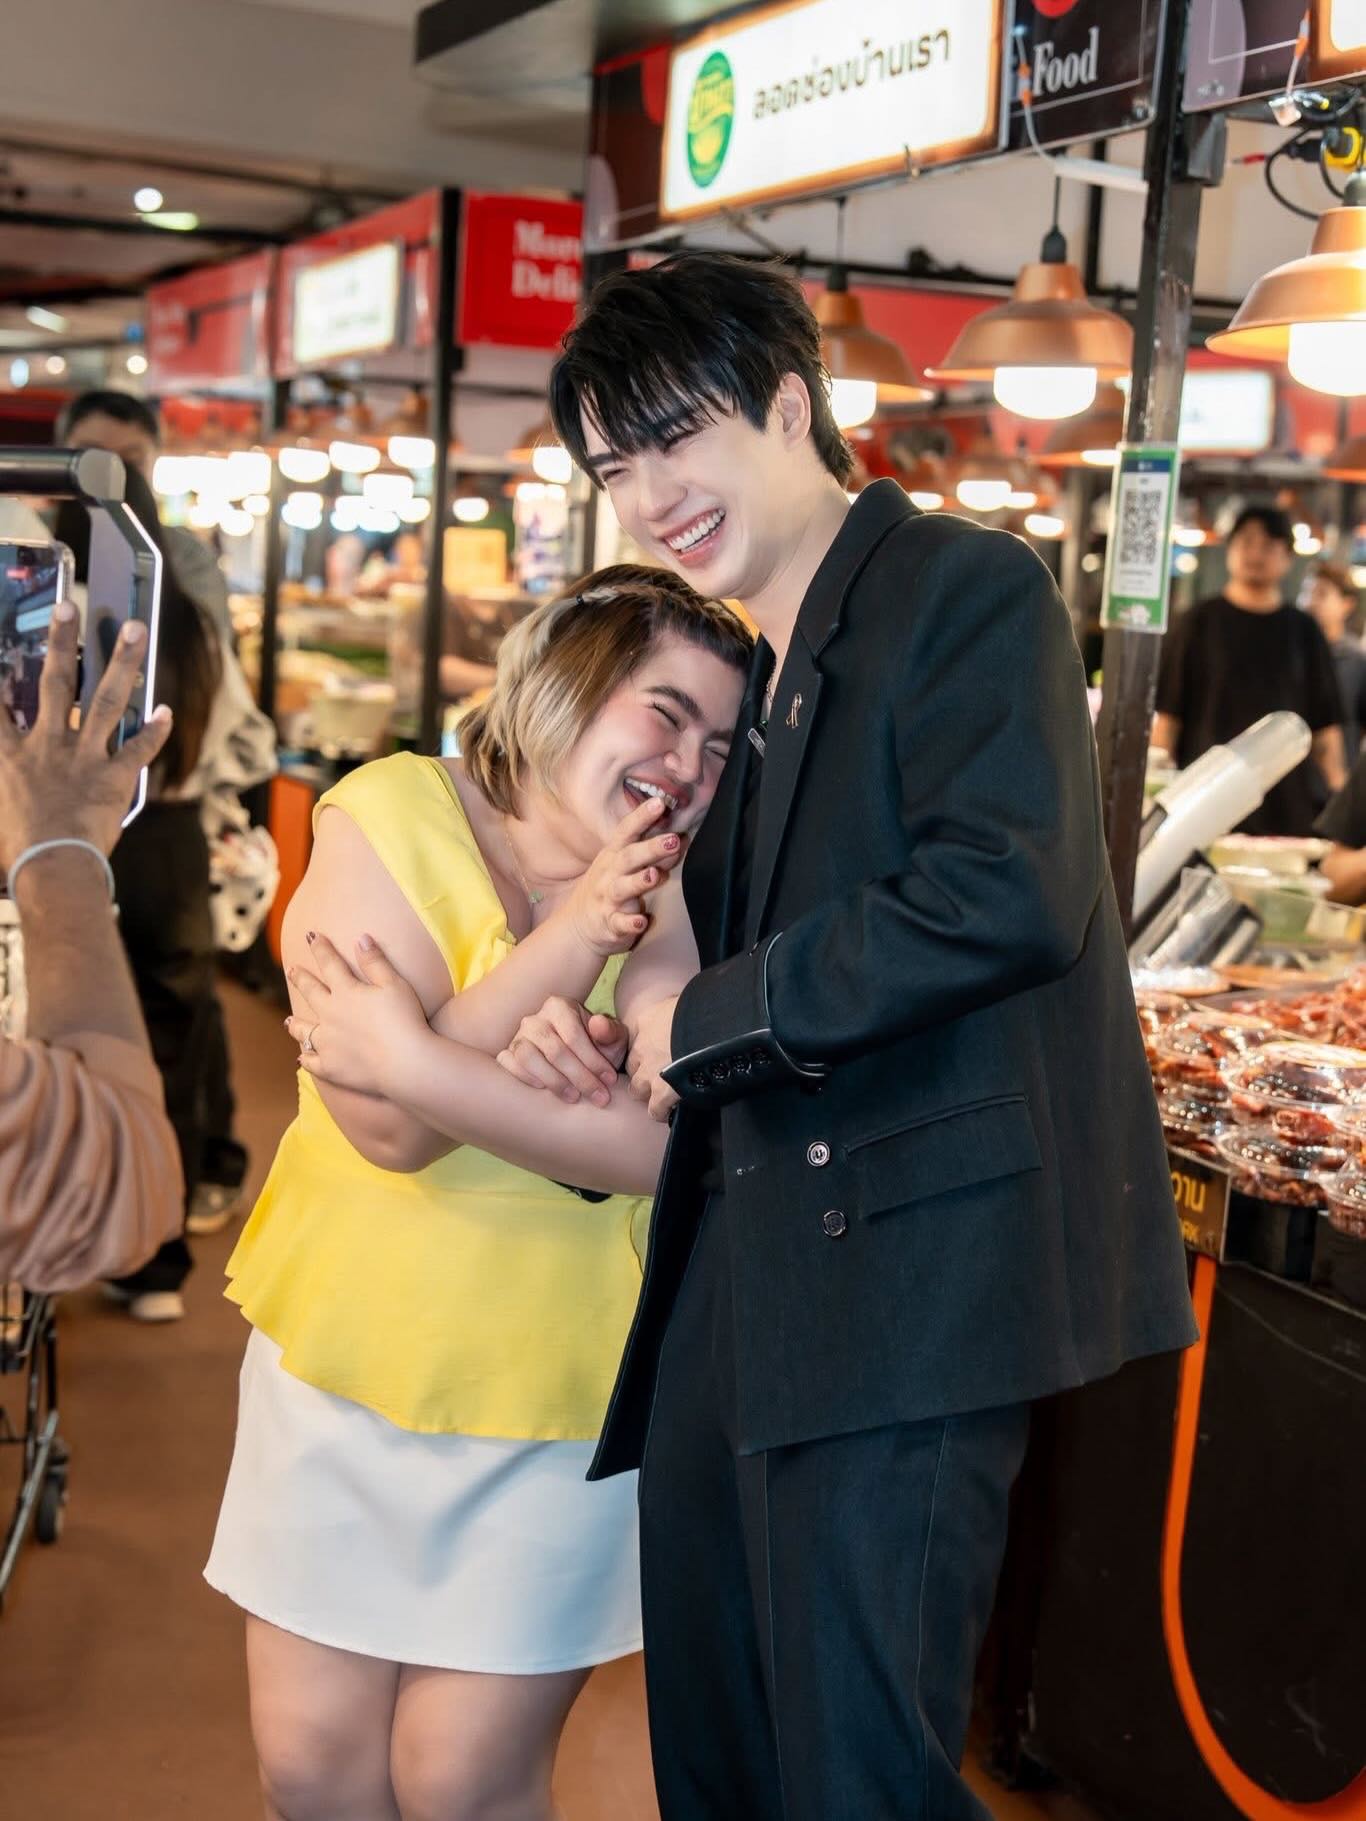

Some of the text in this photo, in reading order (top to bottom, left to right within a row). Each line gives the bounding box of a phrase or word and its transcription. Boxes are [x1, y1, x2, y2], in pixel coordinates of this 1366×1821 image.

[753, 28, 950, 120] ลอดช่องบ้านเรา
[1032, 25, 1100, 97] Food
[511, 259, 583, 302] Deli
[1171, 1171, 1206, 1213] วาน
[1179, 1219, 1201, 1245] RK
